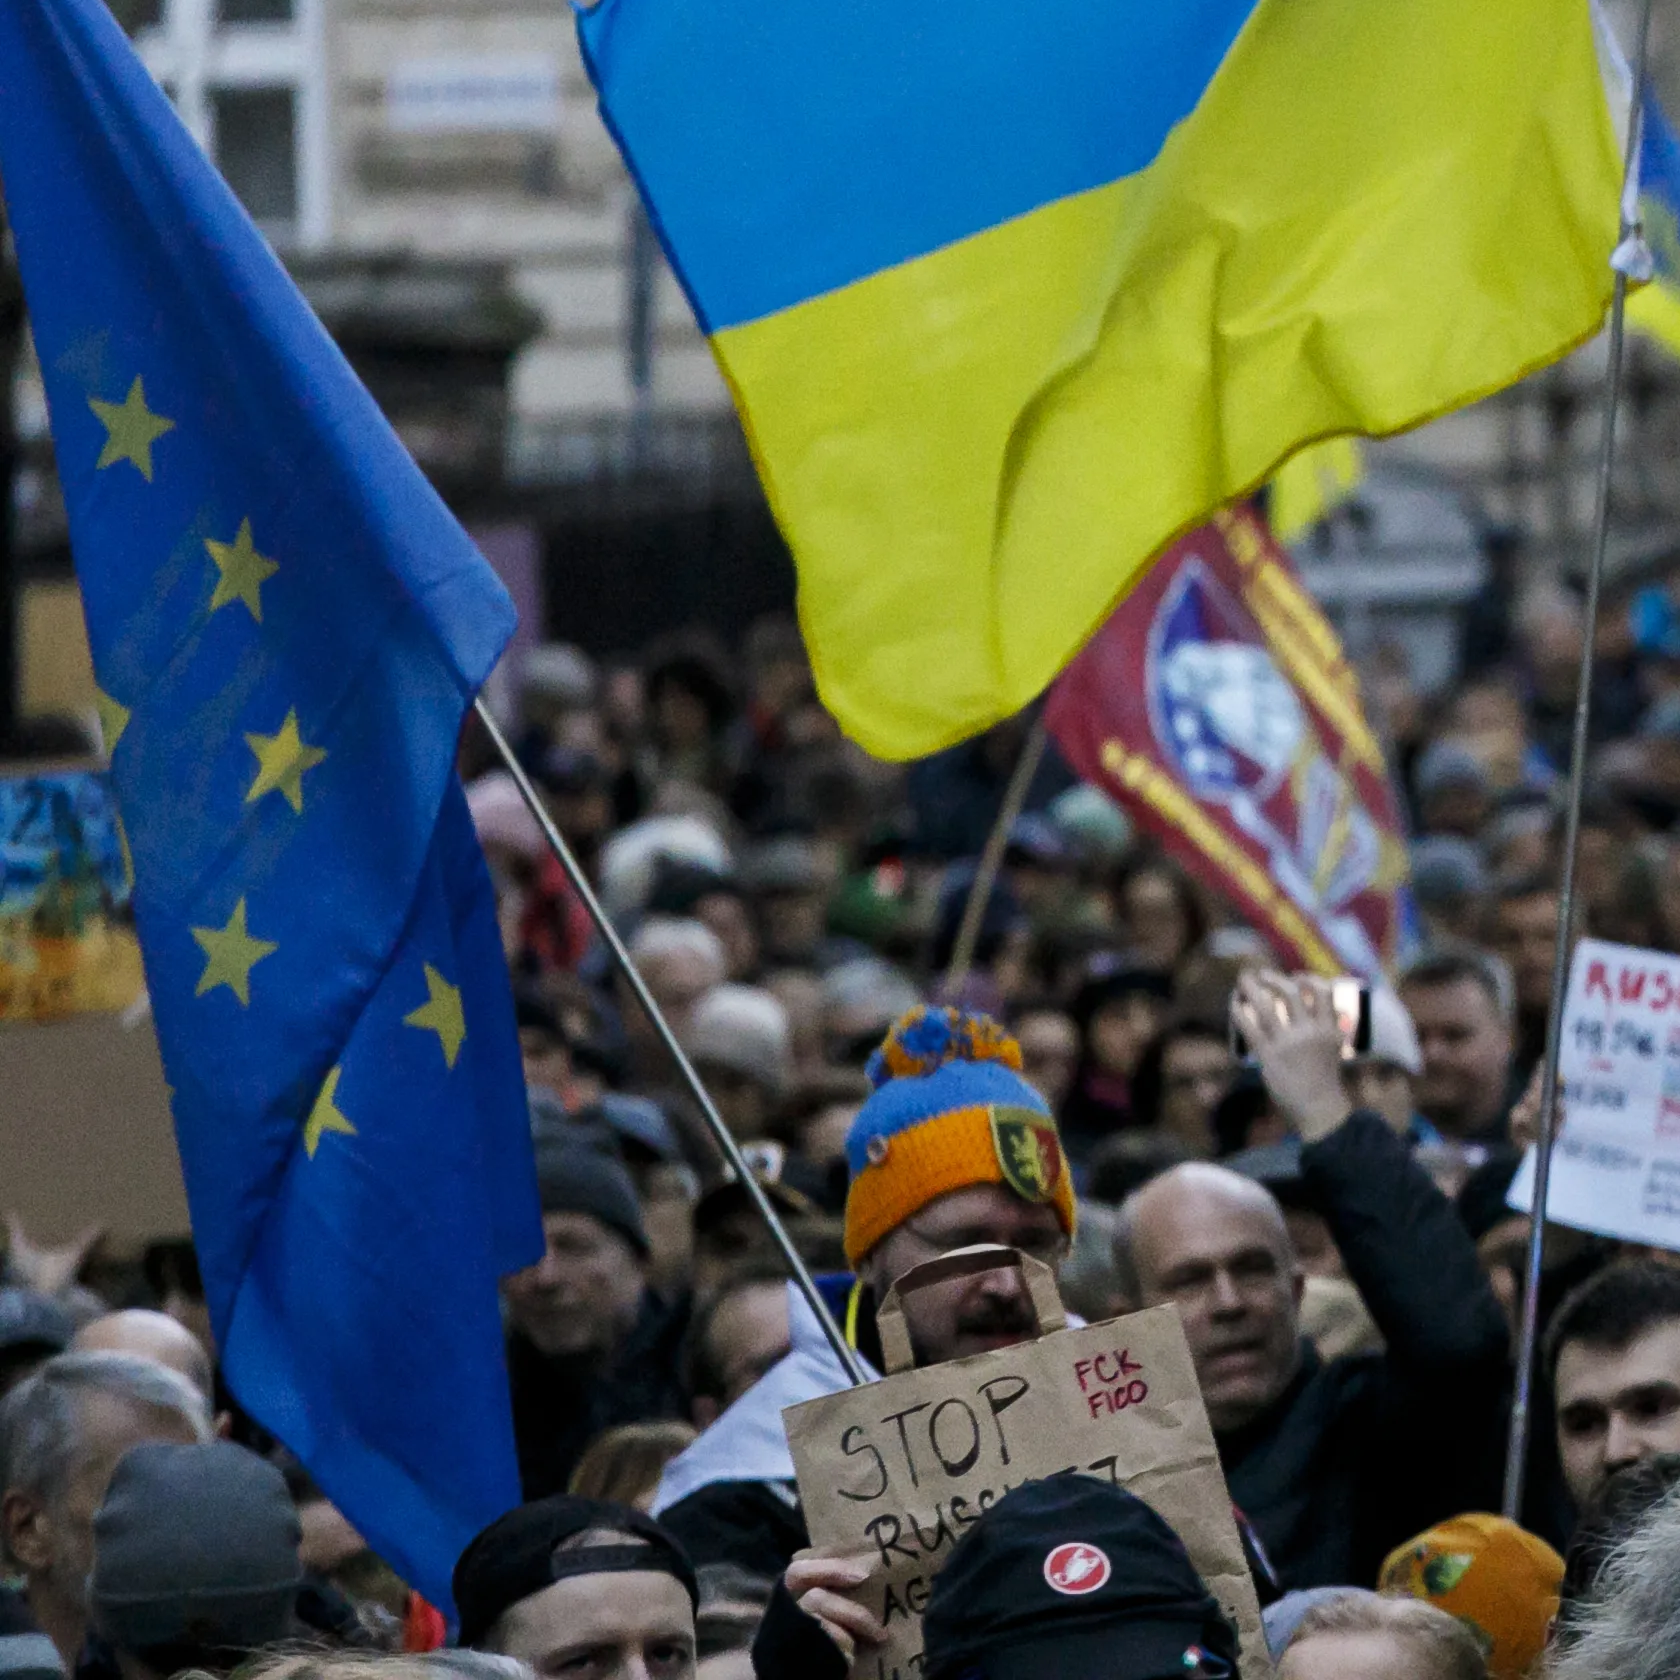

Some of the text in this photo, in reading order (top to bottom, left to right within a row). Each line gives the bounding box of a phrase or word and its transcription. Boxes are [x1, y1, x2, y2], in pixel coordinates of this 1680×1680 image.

[1073, 1348, 1144, 1391] FCK
[1086, 1379, 1149, 1420] FICO
[837, 1375, 1031, 1502] STOP
